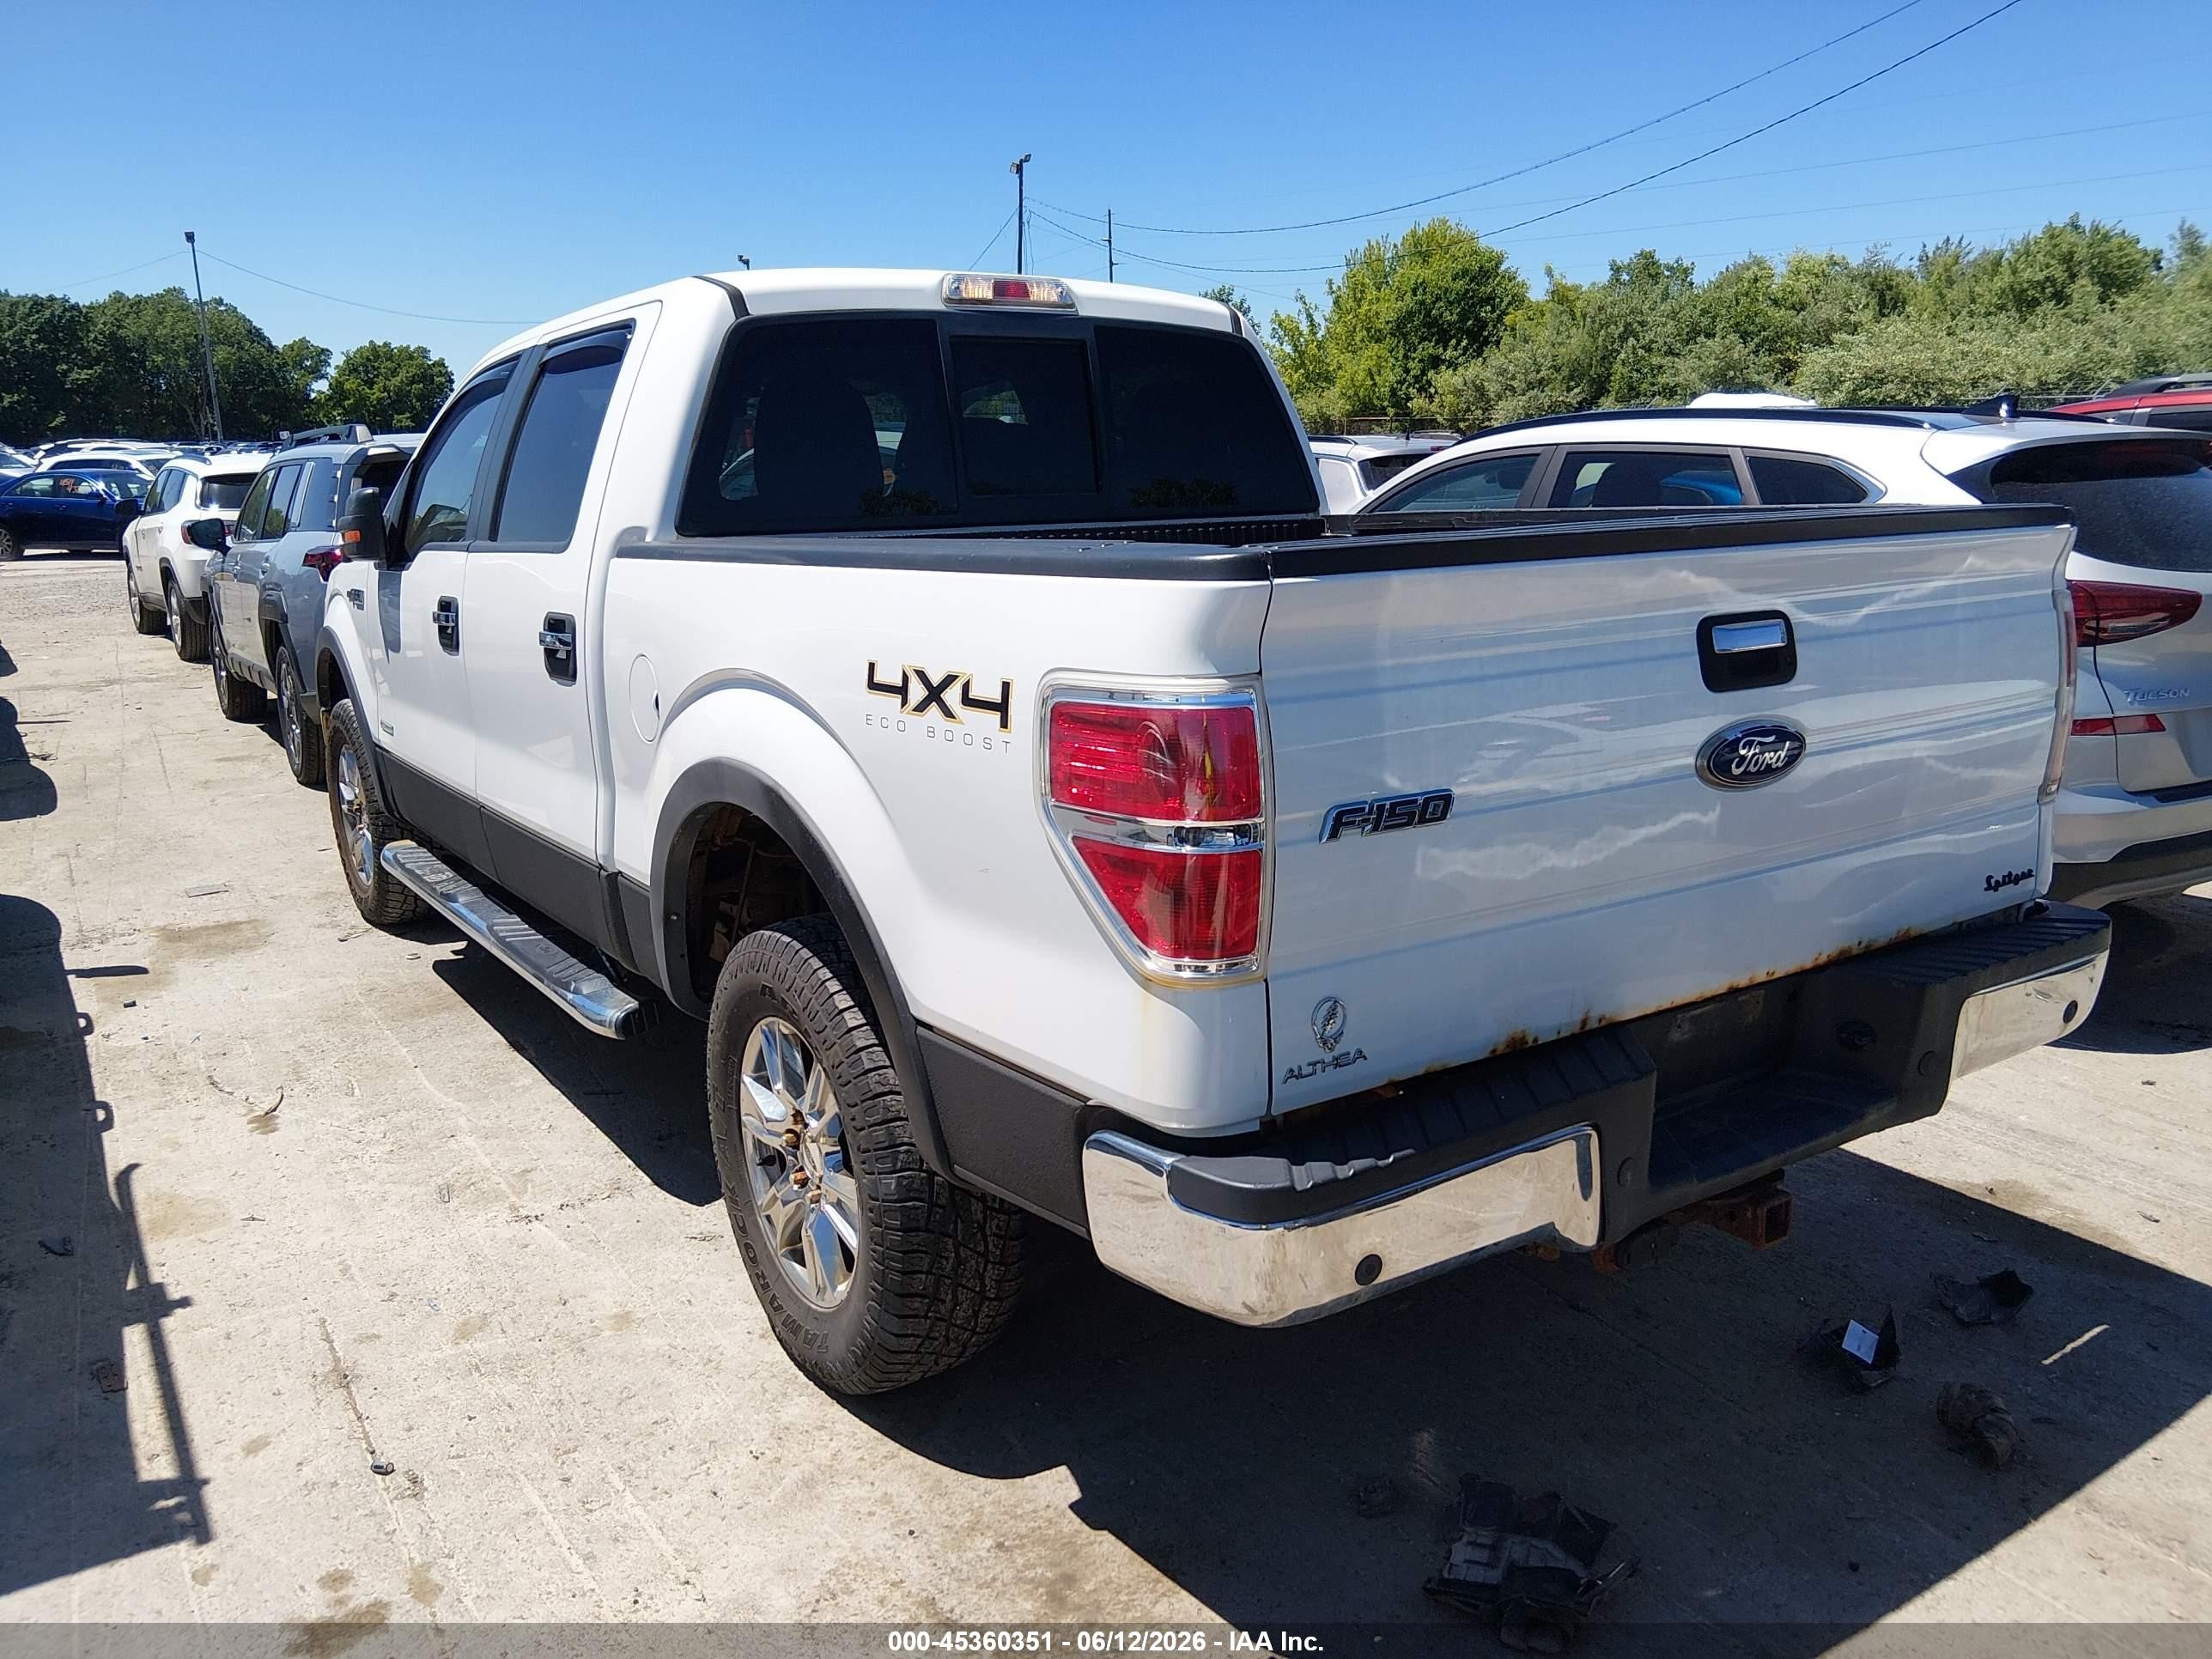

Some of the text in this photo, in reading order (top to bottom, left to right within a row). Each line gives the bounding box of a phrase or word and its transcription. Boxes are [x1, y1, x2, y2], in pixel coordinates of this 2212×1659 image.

[2123, 687, 2191, 702] TUCSON
[866, 714, 1011, 754] ECO BOOST
[1731, 735, 1790, 775] Ford
[1319, 787, 1455, 844] F-150
[1282, 1048, 1368, 1085] ALTHEA
